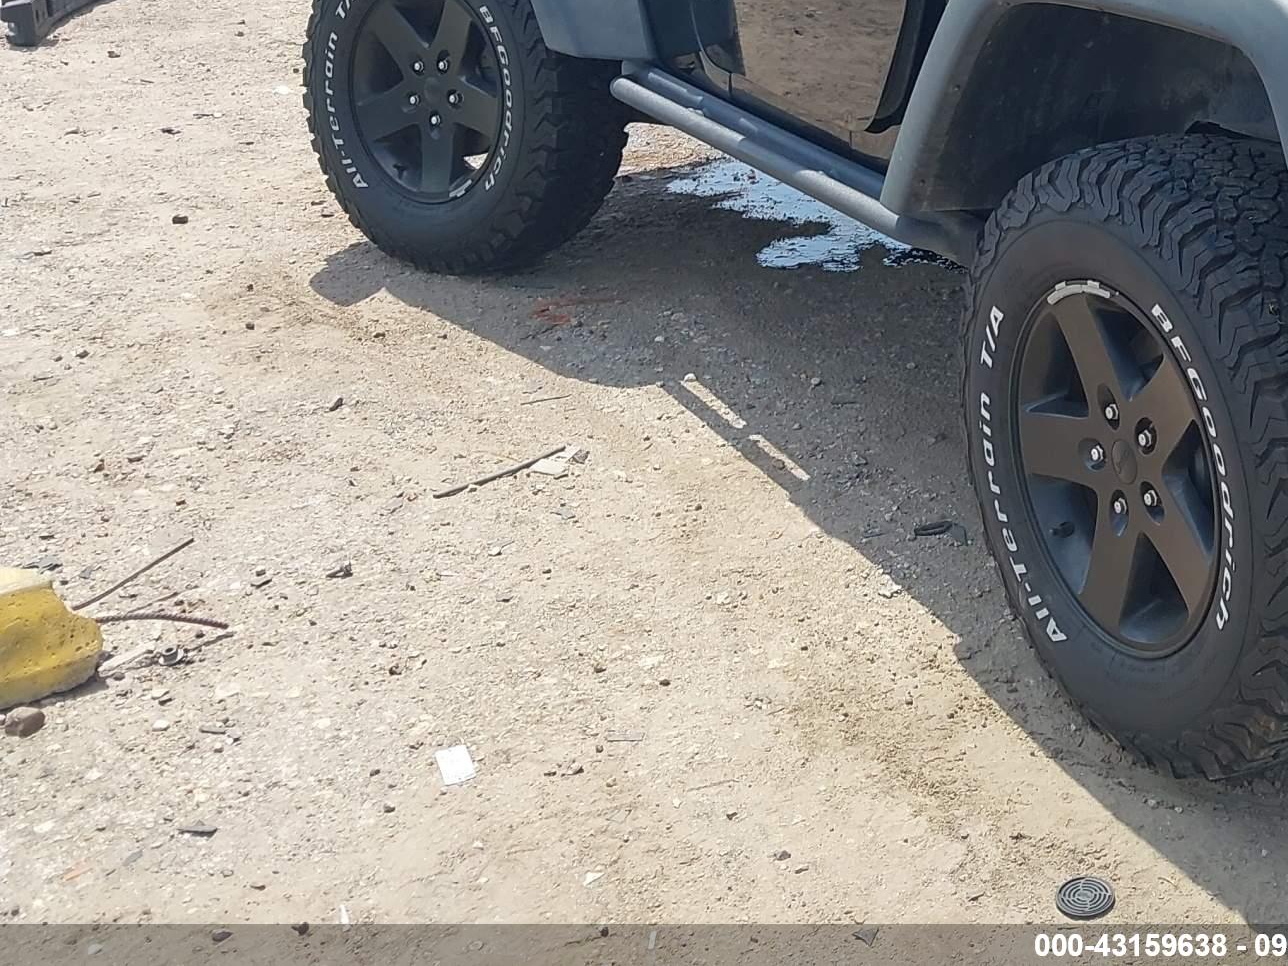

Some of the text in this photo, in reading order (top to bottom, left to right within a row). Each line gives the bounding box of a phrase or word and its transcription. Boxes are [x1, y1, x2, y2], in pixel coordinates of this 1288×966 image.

[479, 5, 514, 192] BFGoodrich
[980, 306, 1004, 369] T/A
[1150, 302, 1239, 630] BFGoodrich
